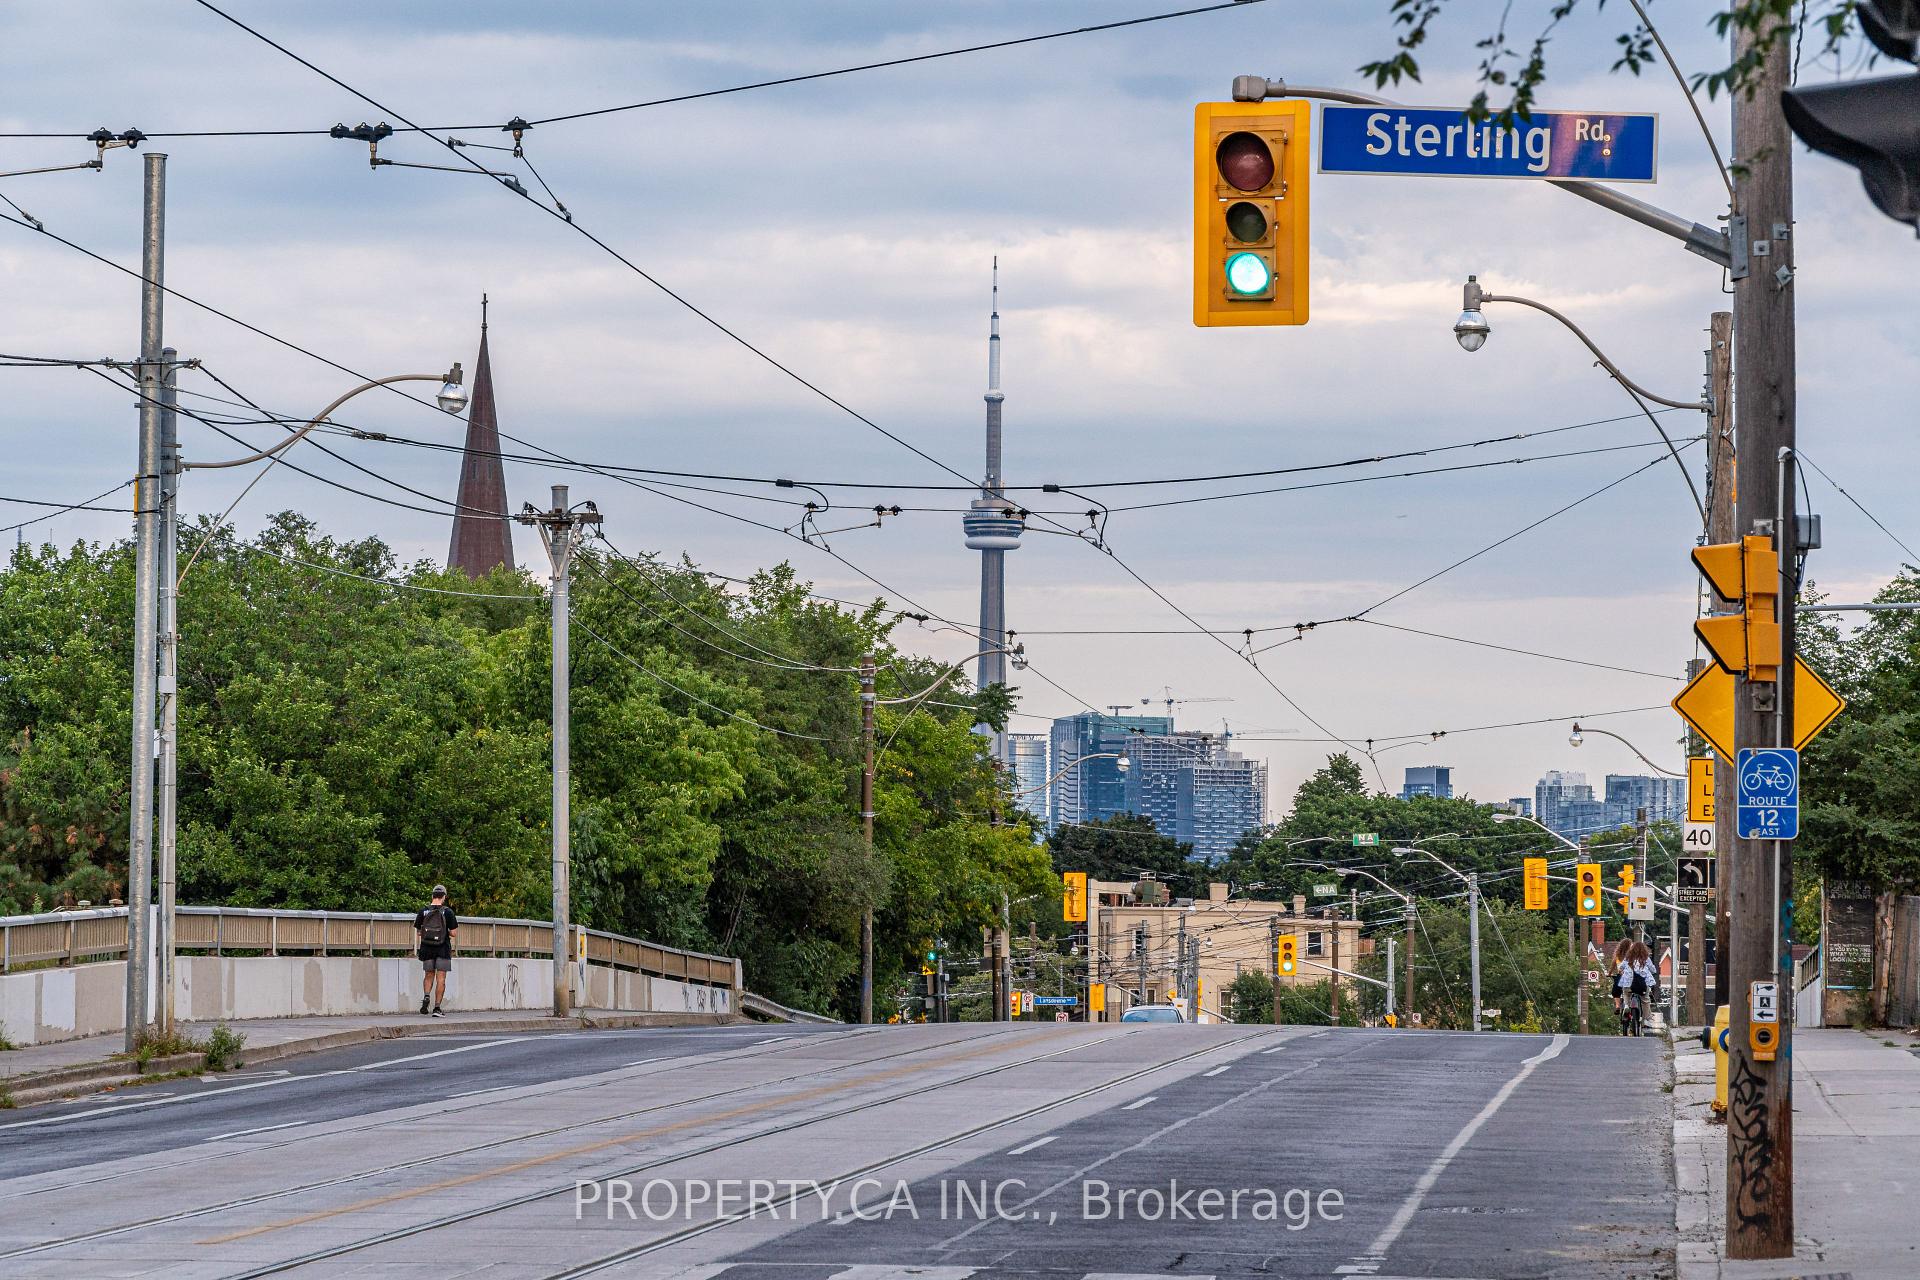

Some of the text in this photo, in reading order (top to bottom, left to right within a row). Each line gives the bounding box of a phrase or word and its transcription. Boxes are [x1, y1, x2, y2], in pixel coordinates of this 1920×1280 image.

[1366, 112, 1552, 173] Sterling
[1749, 796, 1787, 806] ROUTE
[1757, 809, 1779, 826] 12
[1686, 829, 1711, 846] 40
